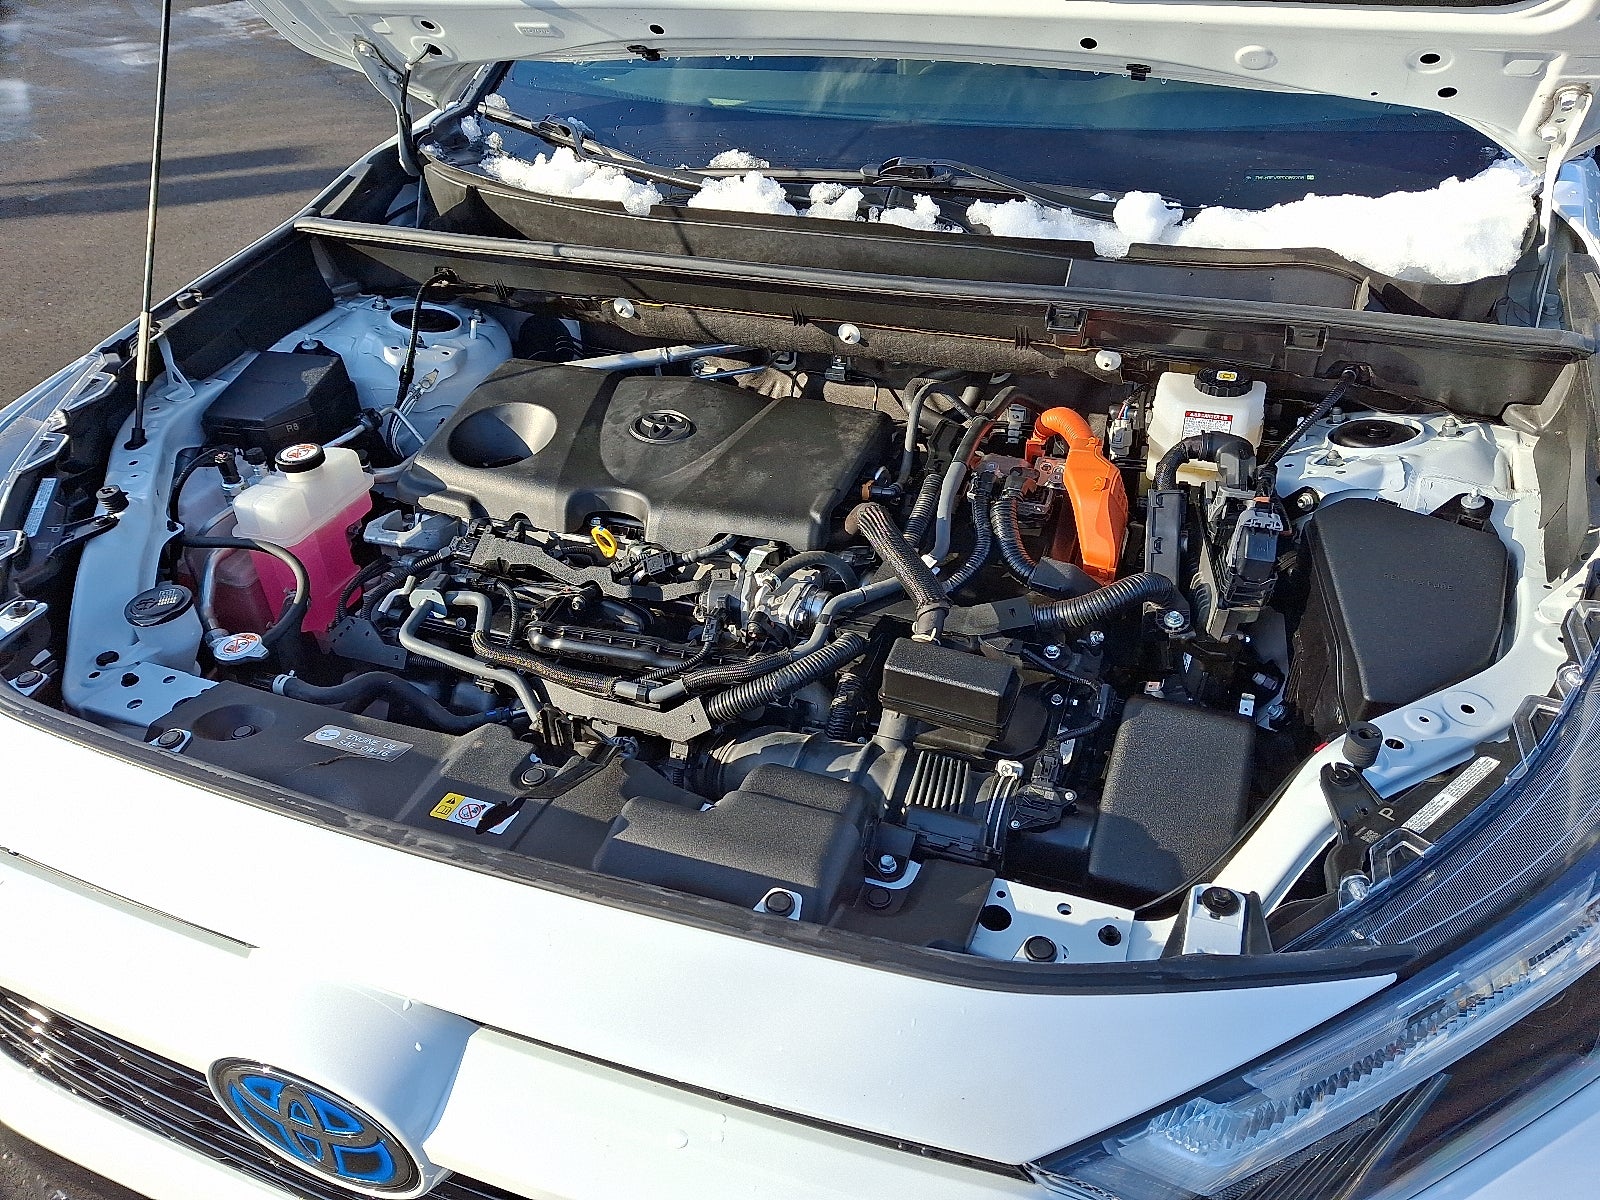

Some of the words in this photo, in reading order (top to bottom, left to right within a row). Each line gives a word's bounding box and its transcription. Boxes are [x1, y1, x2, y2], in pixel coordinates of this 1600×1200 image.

[337, 740, 357, 749] SAE
[346, 734, 380, 746] ENGINE
[1378, 807, 1396, 822] P
